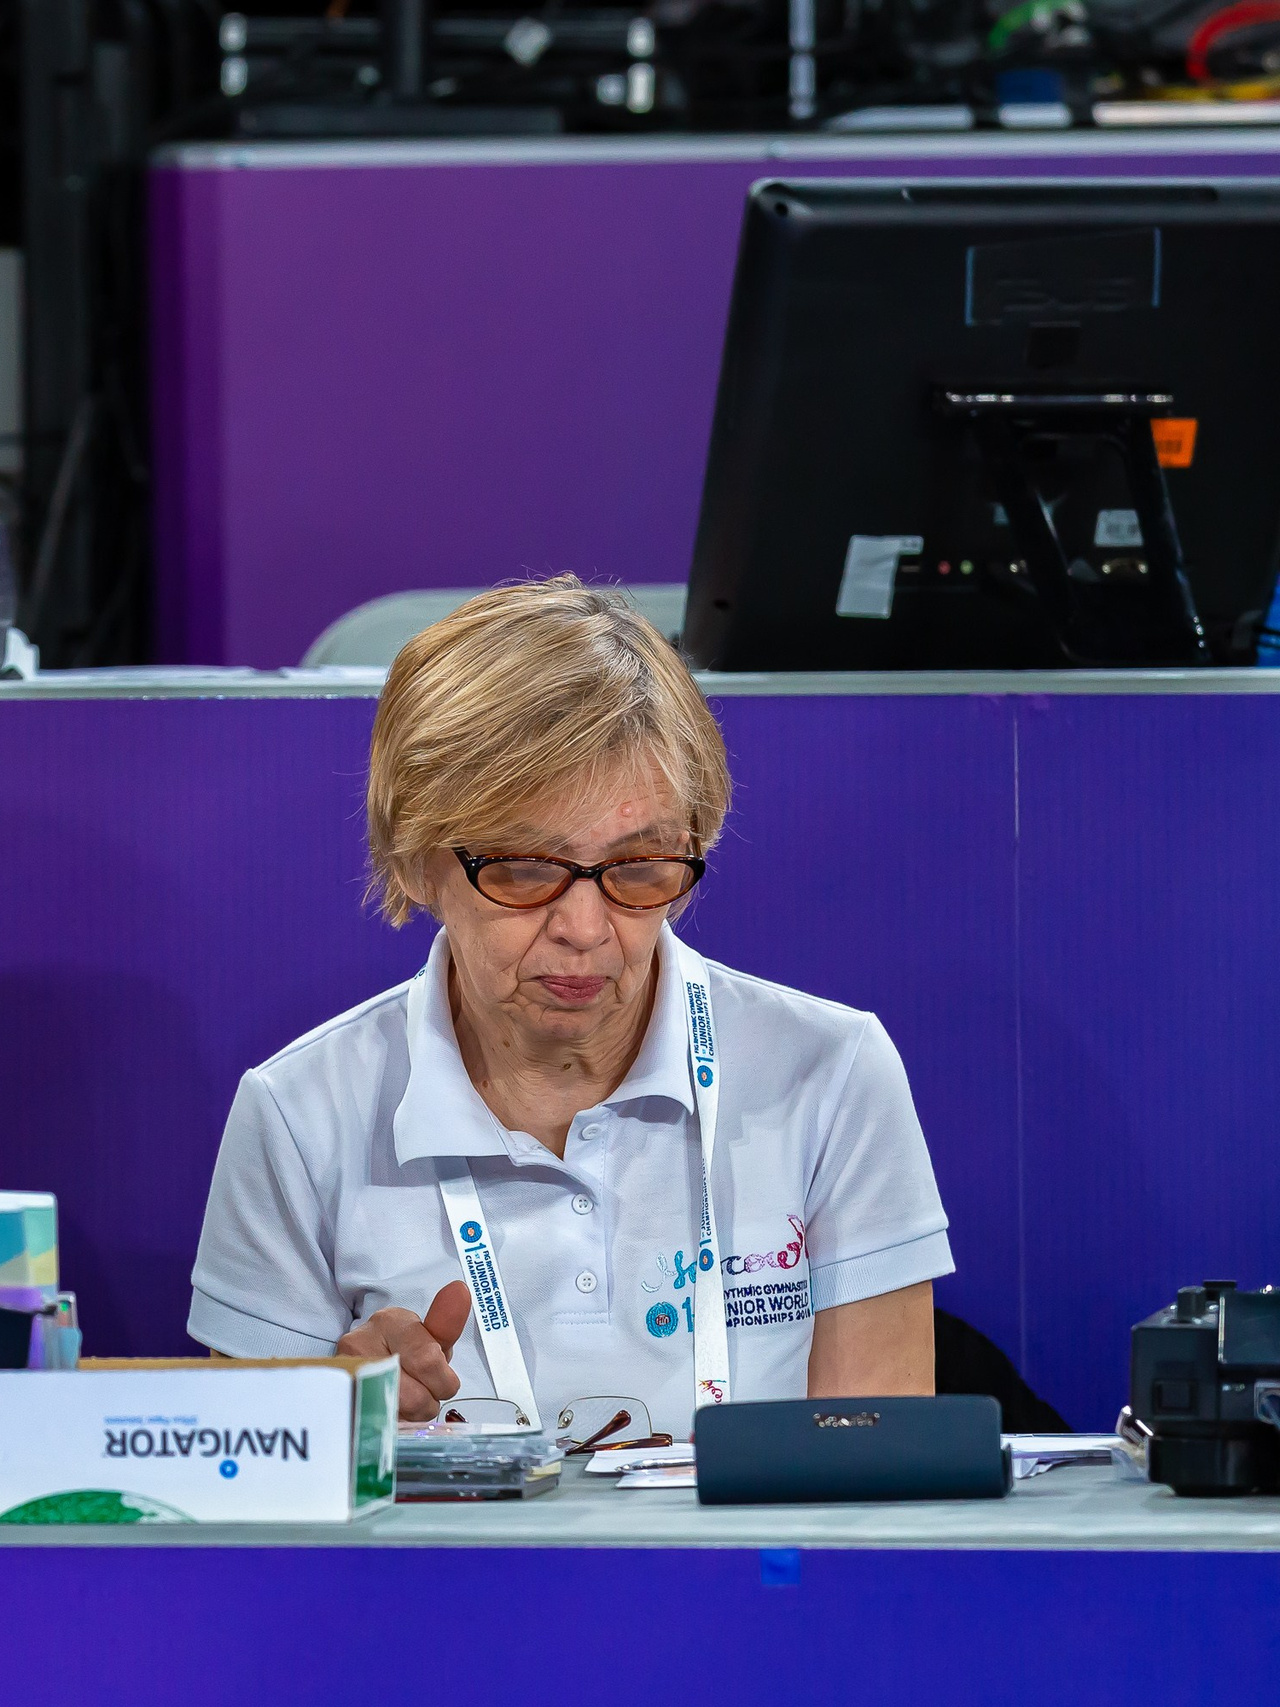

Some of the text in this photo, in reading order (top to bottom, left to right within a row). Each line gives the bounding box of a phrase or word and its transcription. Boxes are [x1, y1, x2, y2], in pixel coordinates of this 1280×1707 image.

[692, 982, 704, 1014] WORLD
[698, 1015, 708, 1048] JUNIOR
[703, 1002, 715, 1056] CHAMPIONSHIPS
[465, 1255, 492, 1332] CHAMPIONSHIPS 2019
[474, 1260, 492, 1294] JUNIOR
[485, 1295, 501, 1330] WORLD
[483, 1250, 509, 1328] FIG RHYTHMIC GYMNASTICS
[768, 1292, 809, 1314] WORLD
